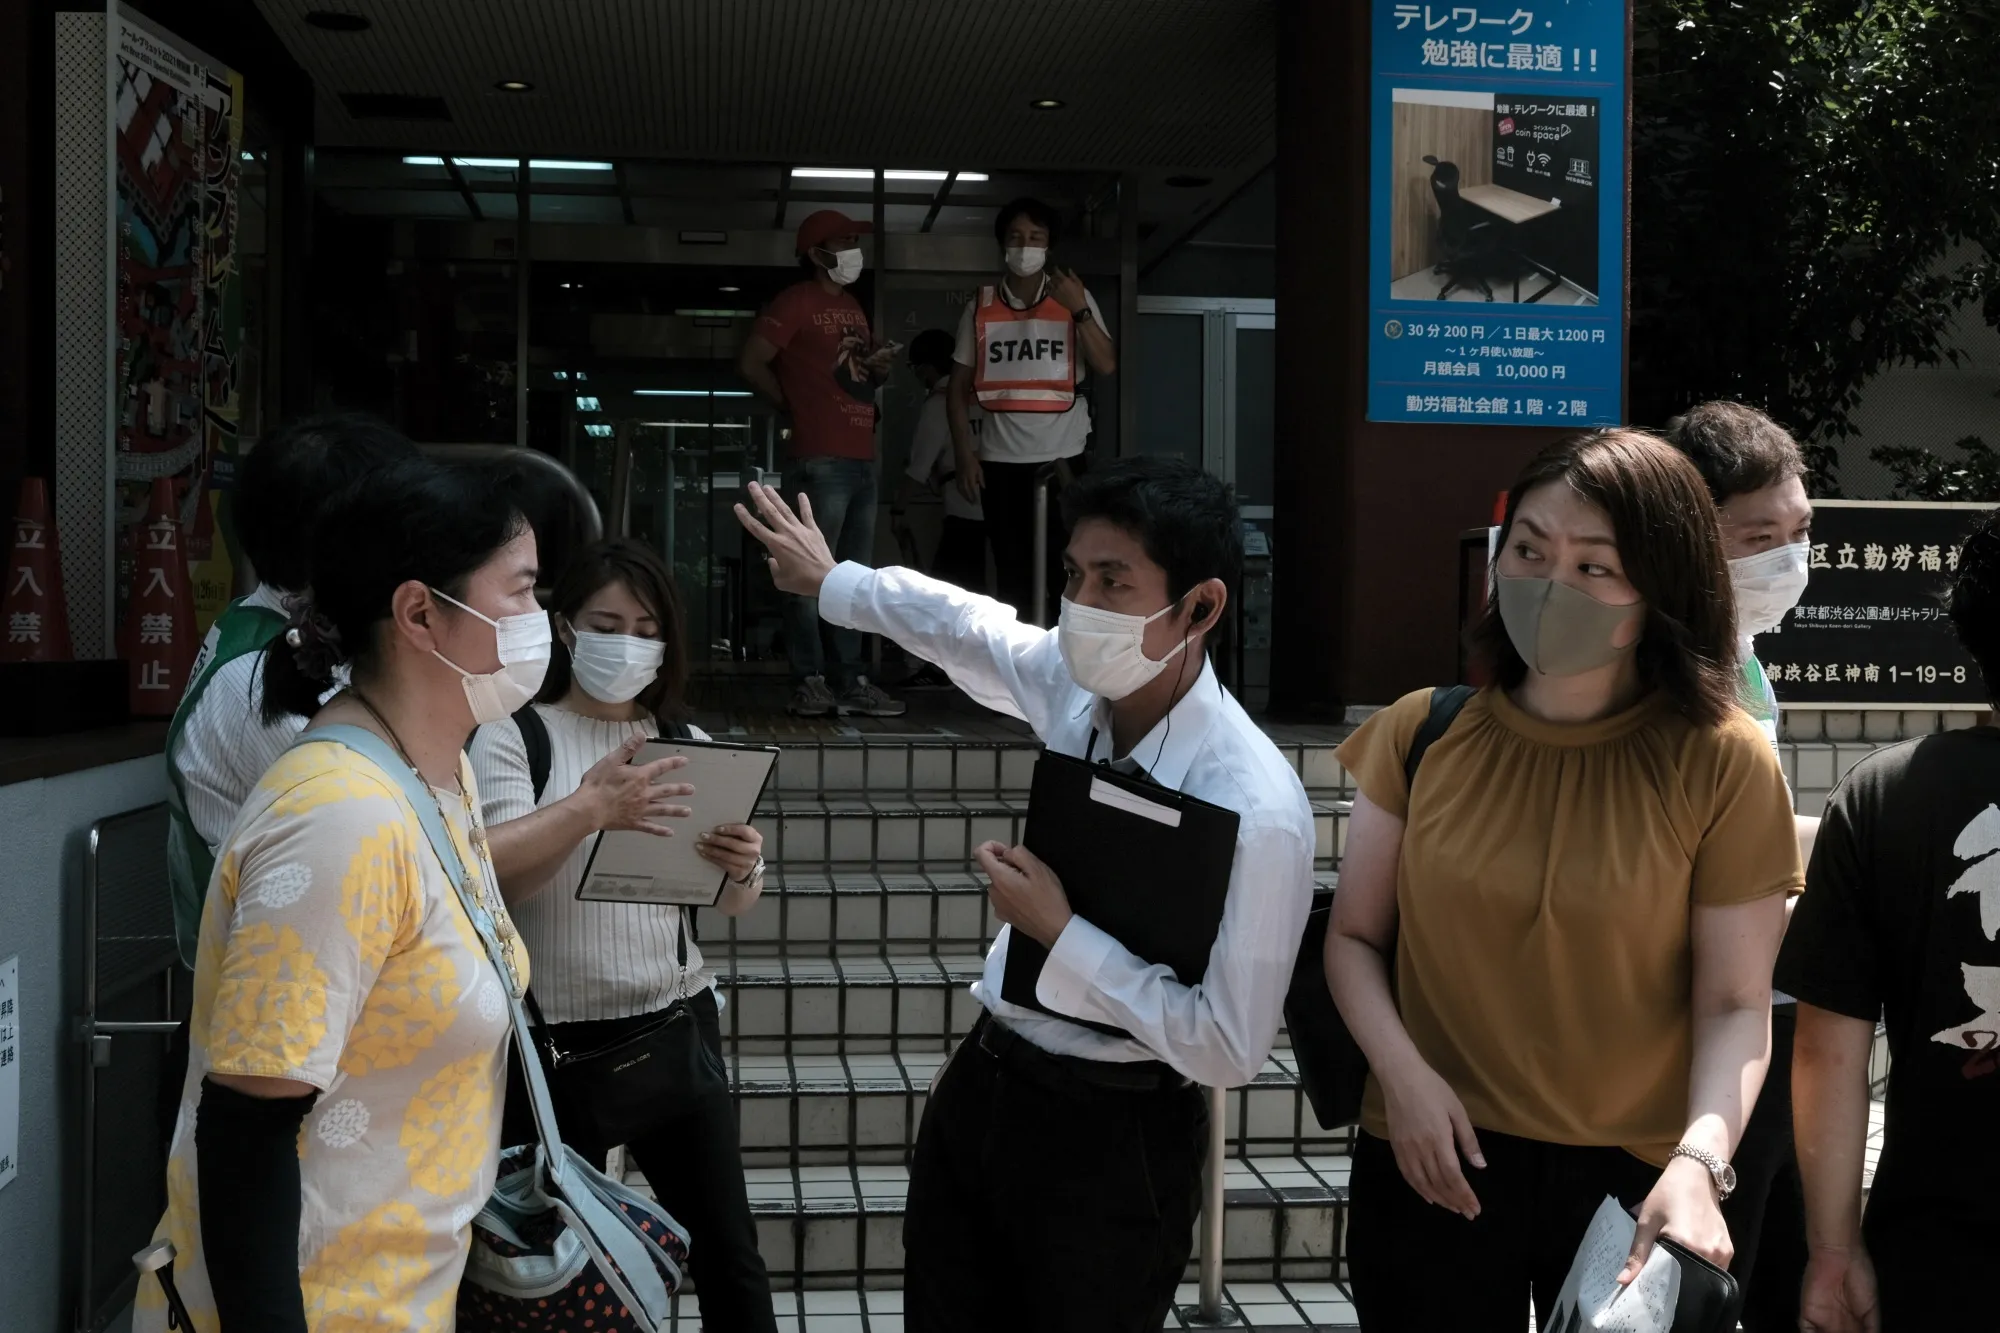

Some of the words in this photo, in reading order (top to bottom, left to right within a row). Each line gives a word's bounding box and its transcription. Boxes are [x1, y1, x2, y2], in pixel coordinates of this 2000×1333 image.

[1515, 128, 1531, 138] coin
[1533, 131, 1560, 143] space
[946, 291, 975, 306] INF
[905, 311, 917, 326] 4
[989, 338, 1064, 363] STAFF
[1423, 361, 1480, 377] 月額会員
[138, 514, 176, 691] 立入禁止
[1794, 605, 1949, 622] 東京都渋谷公園通りギャラリー
